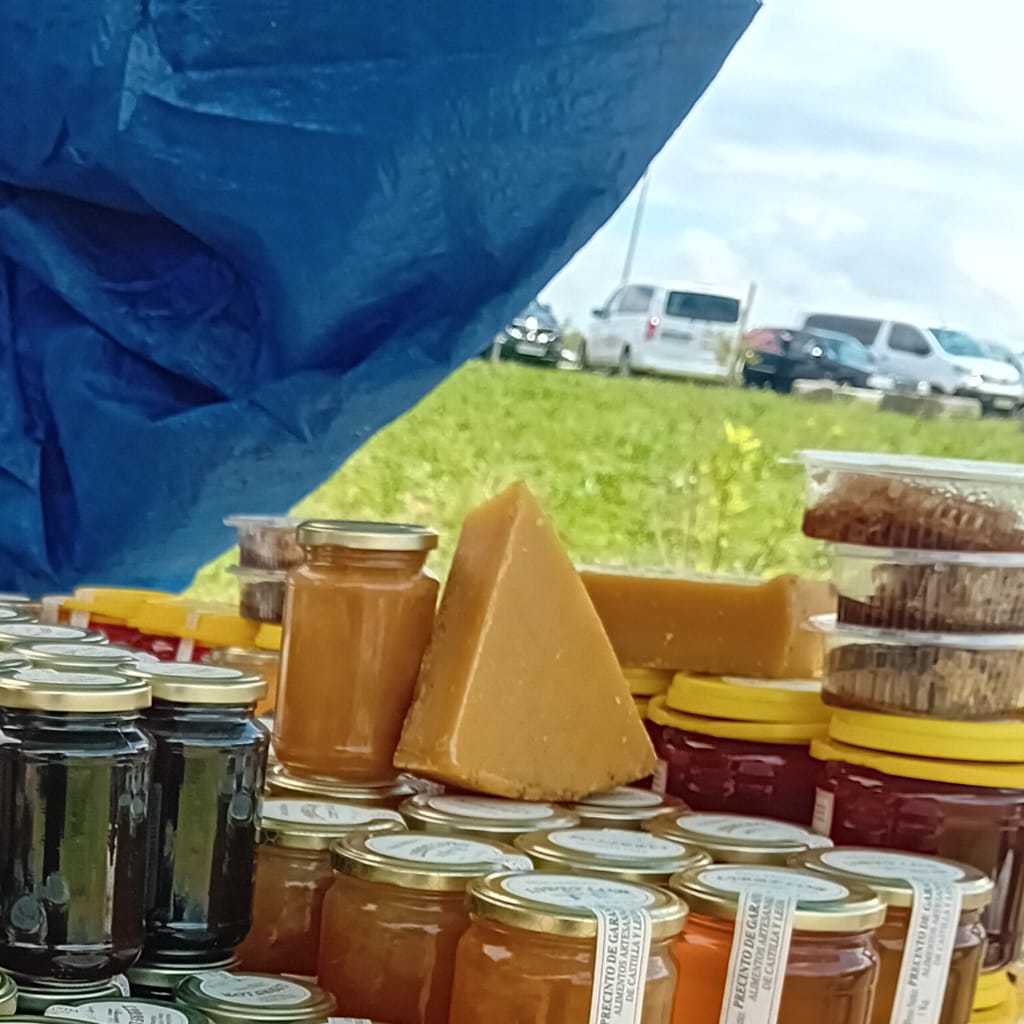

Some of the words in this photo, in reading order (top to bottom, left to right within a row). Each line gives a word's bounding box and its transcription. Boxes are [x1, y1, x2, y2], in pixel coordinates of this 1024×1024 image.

[605, 951, 619, 972] DE
[627, 942, 641, 988] CASTILLA
[734, 953, 753, 1011] PRECINTO
[746, 930, 757, 952] DE
[764, 928, 780, 975] CASTILLA
[614, 958, 628, 1017] ALIMENTOS
